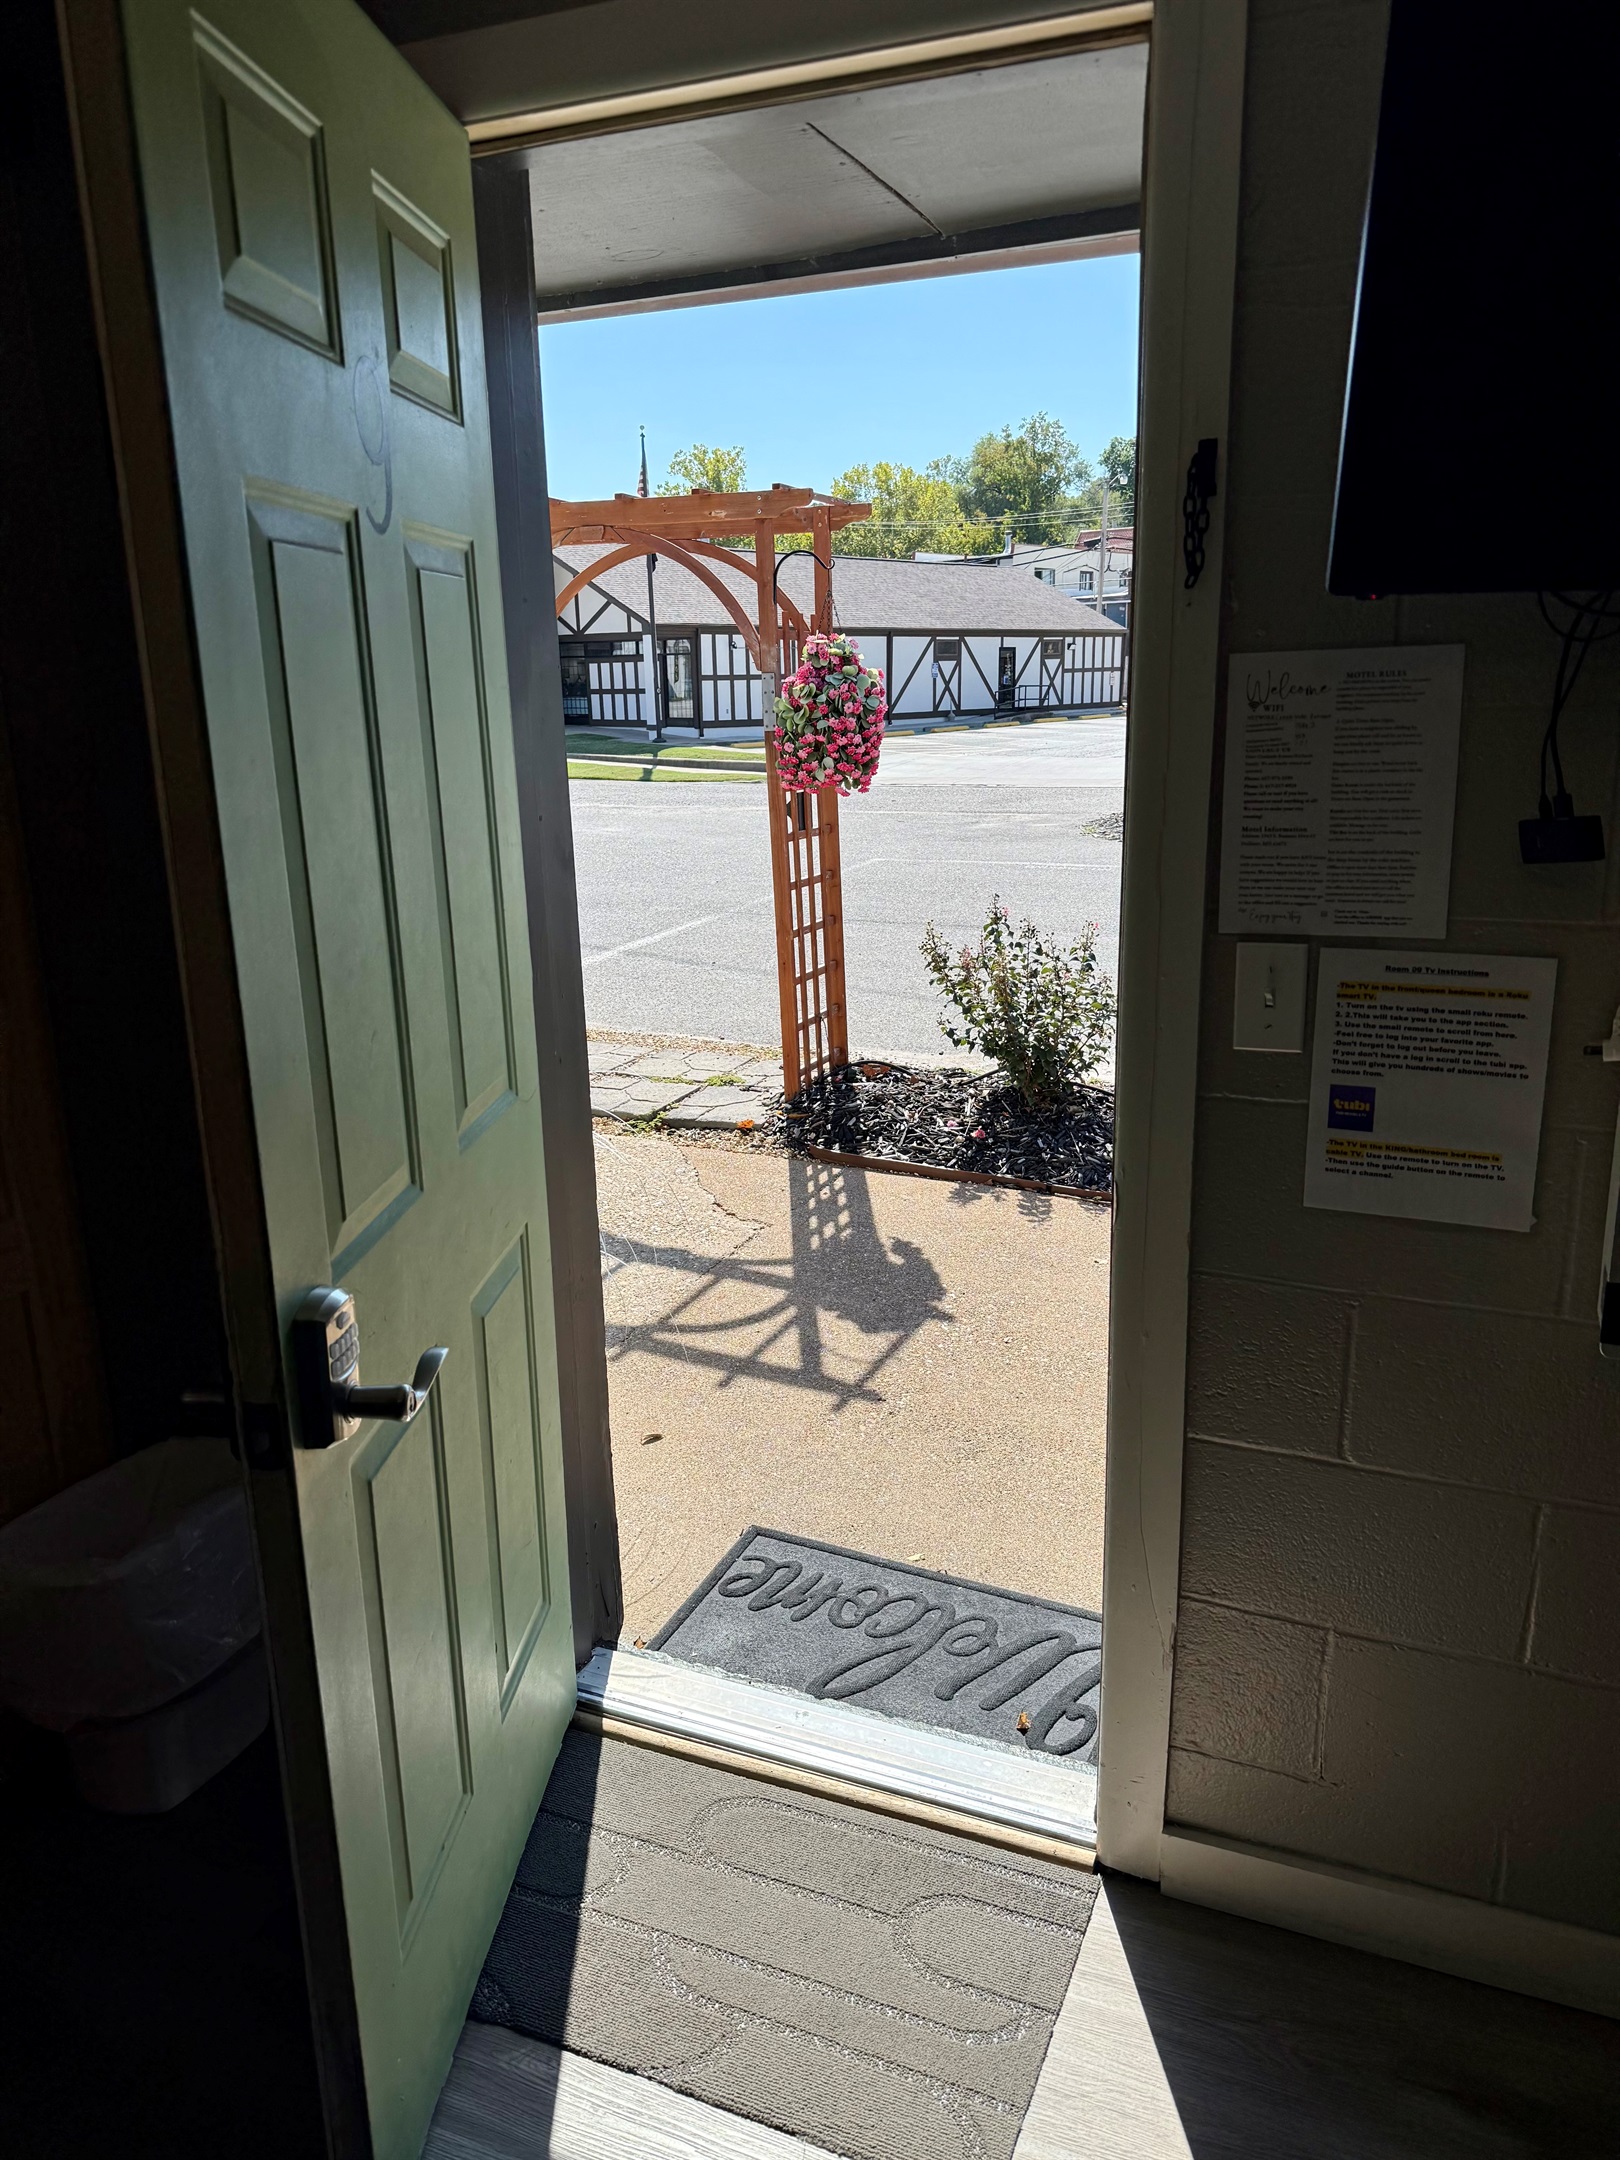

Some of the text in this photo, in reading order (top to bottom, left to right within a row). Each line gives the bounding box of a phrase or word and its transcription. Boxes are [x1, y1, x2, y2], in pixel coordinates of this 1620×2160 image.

[1346, 671, 1376, 679] MOTEL
[1246, 669, 1331, 704] Welcome
[1263, 704, 1284, 712] WIFI
[1424, 966, 1436, 974] Tv
[1437, 967, 1489, 976] Instructions
[1447, 988, 1486, 997] bedroom
[1505, 991, 1529, 999] Roku
[1345, 1001, 1365, 1009] Turn
[1405, 1005, 1429, 1014] using
[1472, 1009, 1493, 1017] roku
[1494, 1011, 1528, 1019] remote.
[1410, 1016, 1426, 1024] you
[1473, 1019, 1509, 1028] section.
[1403, 1025, 1434, 1033] remote
[1446, 1027, 1471, 1035] scroll
[1472, 1029, 1493, 1037] from
[1494, 1031, 1517, 1039] here.
[1385, 1033, 1399, 1041] log
[1419, 1036, 1439, 1044] your
[1440, 1036, 1474, 1045] favorite
[1475, 1040, 1494, 1048] app.
[1358, 1041, 1384, 1050] forget
[1396, 1043, 1410, 1051] log
[1428, 1045, 1456, 1054] before
[1475, 1049, 1501, 1057] leave.
[1331, 1057, 1350, 1065] This
[1367, 1060, 1386, 1069] give
[1405, 1063, 1444, 1072] hundreds
[1357, 1050, 1378, 1058] don't
[1410, 1053, 1424, 1062] log
[1435, 1056, 1460, 1064] scroll
[1489, 1060, 1506, 1068] tubi
[1330, 1067, 1384, 1077] choose from.
[1333, 1098, 1370, 1112] tubi
[1359, 1141, 1367, 1149] in
[1467, 1153, 1490, 1161] room
[1491, 1154, 1500, 1162] is
[1325, 1148, 1348, 1156] cable
[1365, 1151, 1382, 1159] Use
[1383, 1153, 1397, 1161] the
[1398, 1155, 1429, 1164] remote
[1441, 1159, 1459, 1167] turn
[1474, 1162, 1488, 1170] the
[1324, 1165, 1349, 1174] select
[1358, 1169, 1393, 1179] channel.
[1381, 1162, 1405, 1172] guide
[1406, 1165, 1434, 1174] button
[1463, 1171, 1494, 1180] remote
